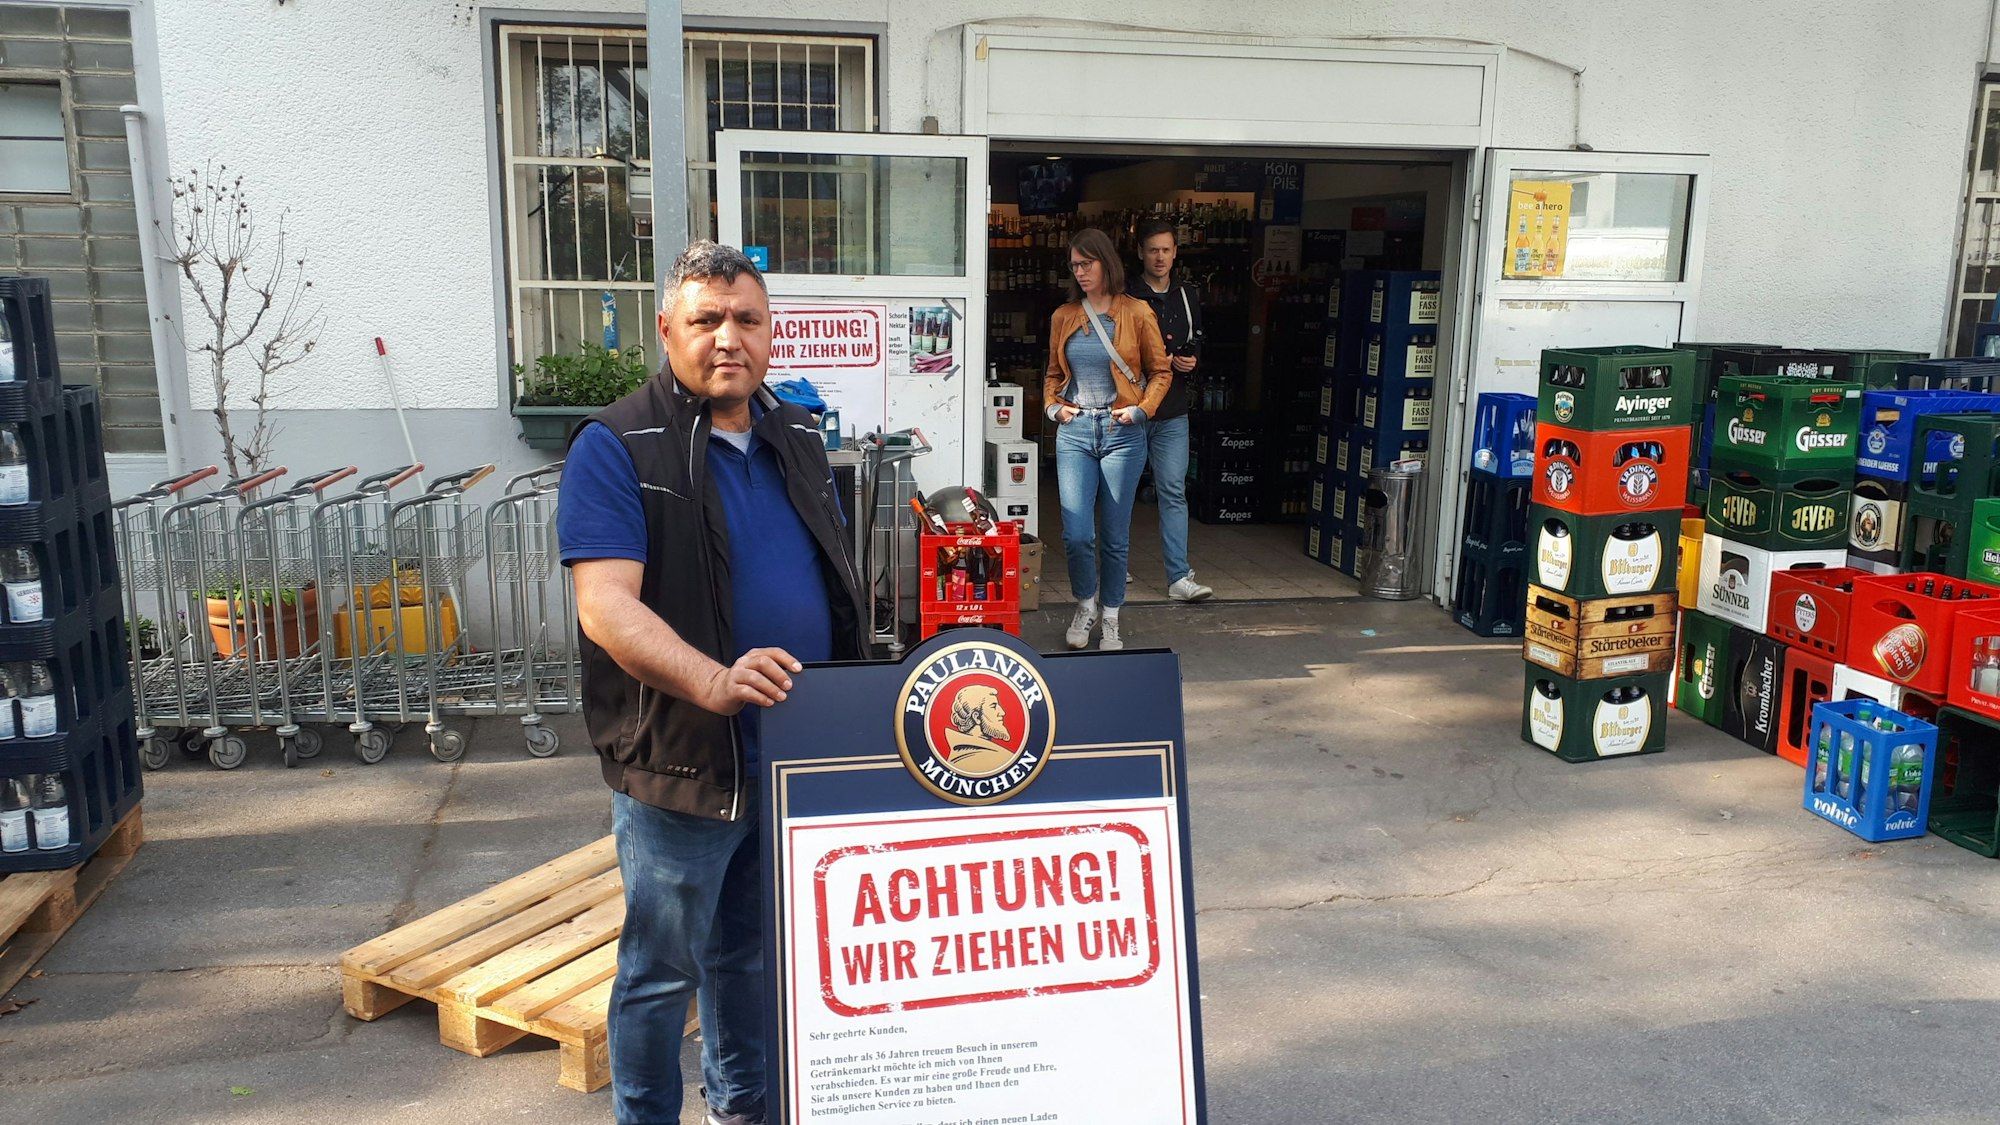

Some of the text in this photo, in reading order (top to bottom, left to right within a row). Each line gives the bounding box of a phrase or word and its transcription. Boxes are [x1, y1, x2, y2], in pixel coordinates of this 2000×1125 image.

[1264, 162, 1297, 176] Köln
[1518, 201, 1534, 209] bee
[1543, 201, 1563, 211] hero
[1419, 301, 1437, 310] FASS
[773, 319, 868, 340] ACHTUNG!
[800, 344, 845, 359] ZIEHEN
[852, 343, 874, 357] UM
[1415, 355, 1433, 364] FASS
[1412, 407, 1430, 416] FASS
[1615, 395, 1672, 414] Ayinger
[1728, 417, 1767, 445] Gösser
[1796, 426, 1848, 452] Gösser
[1221, 437, 1254, 449] Zappes
[1546, 461, 1573, 483] ERDINGER
[1621, 463, 1657, 484] ERDINGER
[1879, 460, 1900, 473] WEISSE
[1221, 472, 1254, 484] Zappes
[1219, 509, 1252, 521] Zappes
[1723, 496, 1757, 526] JEVER
[1792, 505, 1836, 532] JEVER
[1542, 549, 1568, 569] Bitburger
[1608, 559, 1653, 576] Bitburger
[1713, 584, 1750, 610] SÜNNER
[1796, 607, 1815, 619] PETERS
[1531, 624, 1572, 647] Störtebeker
[1590, 634, 1664, 653] Störtebeker
[1698, 643, 1716, 699] Gösser
[906, 650, 1043, 715] PAULANER
[1755, 656, 1774, 733] Krombacher
[1533, 708, 1560, 731] Bitburger
[1600, 722, 1643, 738] Bitburger
[919, 750, 1038, 796] MÜNCHEN
[1813, 798, 1857, 829] volvic
[1885, 817, 1916, 831] volvic
[853, 850, 1120, 927] ACHTUNG!
[841, 917, 1138, 986] WIR ZIEHEN UM
[809, 1025, 907, 1041] Sehr geehrte Kunden,
[810, 1040, 1038, 1066] nach mehr als 36 Jahren treuem Besuch in unserem
[810, 1055, 1003, 1078] Getränkemarkt möchte ich mich von Ihnen
[810, 1078, 878, 1091] verabschieden.
[880, 1075, 891, 1085] Es
[893, 1075, 911, 1083] war
[913, 1072, 929, 1082] mir
[932, 1071, 953, 1081] eine
[952, 1069, 978, 1081] große
[980, 1066, 1011, 1077] Freude
[1014, 1064, 1030, 1074] und
[811, 1078, 1019, 1104] Sie als unsere Kunden zu haben und Ihnen den
[811, 1096, 956, 1117] bestmöglichen Service zu bieten.
[975, 1117, 999, 1125] einen
[1001, 1115, 1027, 1124] neuen
[1030, 1112, 1058, 1122] Laden
